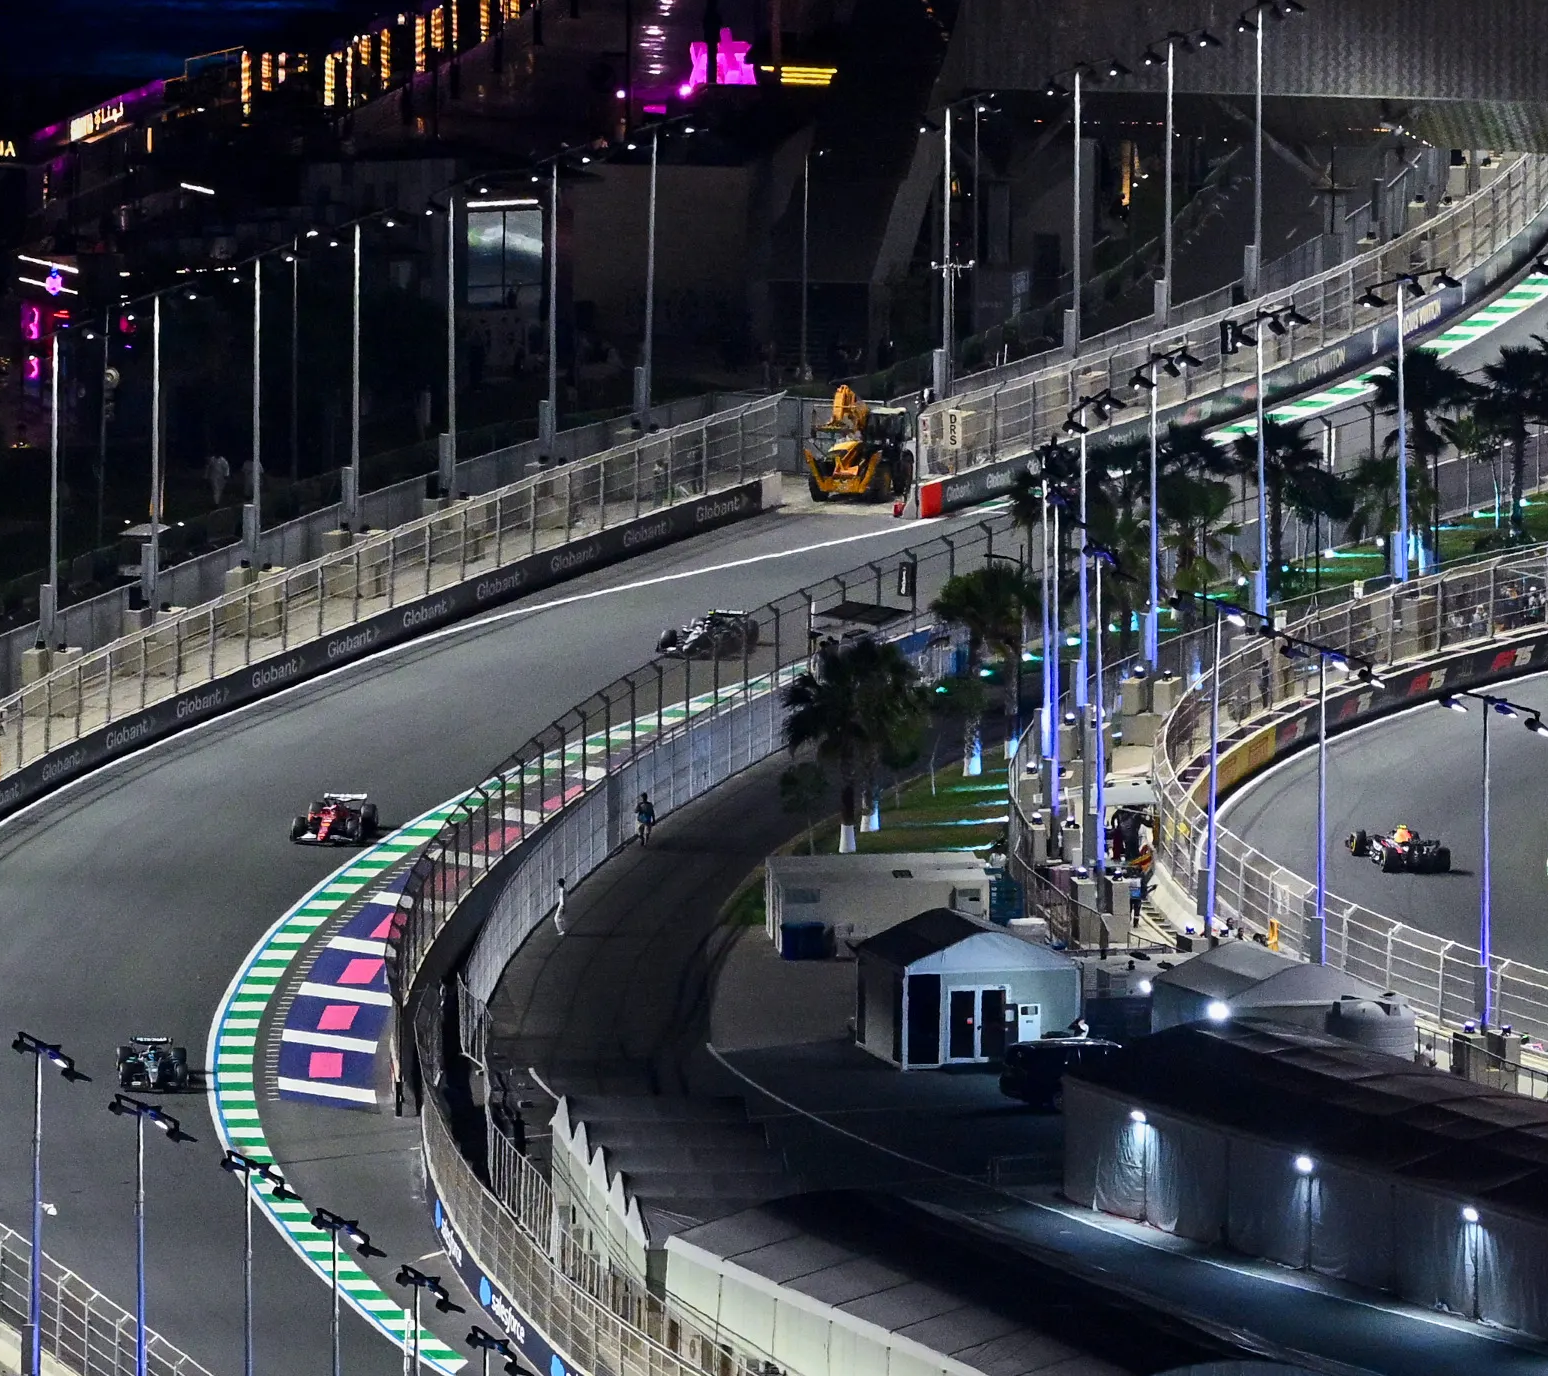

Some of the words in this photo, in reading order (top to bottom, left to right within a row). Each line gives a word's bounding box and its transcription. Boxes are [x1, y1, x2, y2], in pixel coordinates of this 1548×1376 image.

[948, 413, 957, 447] DRS
[696, 494, 741, 522] Globant
[623, 519, 669, 548] Globant
[550, 544, 595, 573] Globant
[476, 570, 522, 600] Globant
[402, 598, 448, 628] Globant
[327, 627, 374, 657] Globant
[252, 656, 299, 688] Globant
[177, 687, 223, 719] Globant
[106, 718, 150, 750] Globant
[42, 746, 81, 781] Globant
[491, 1292, 525, 1344] salesforce
